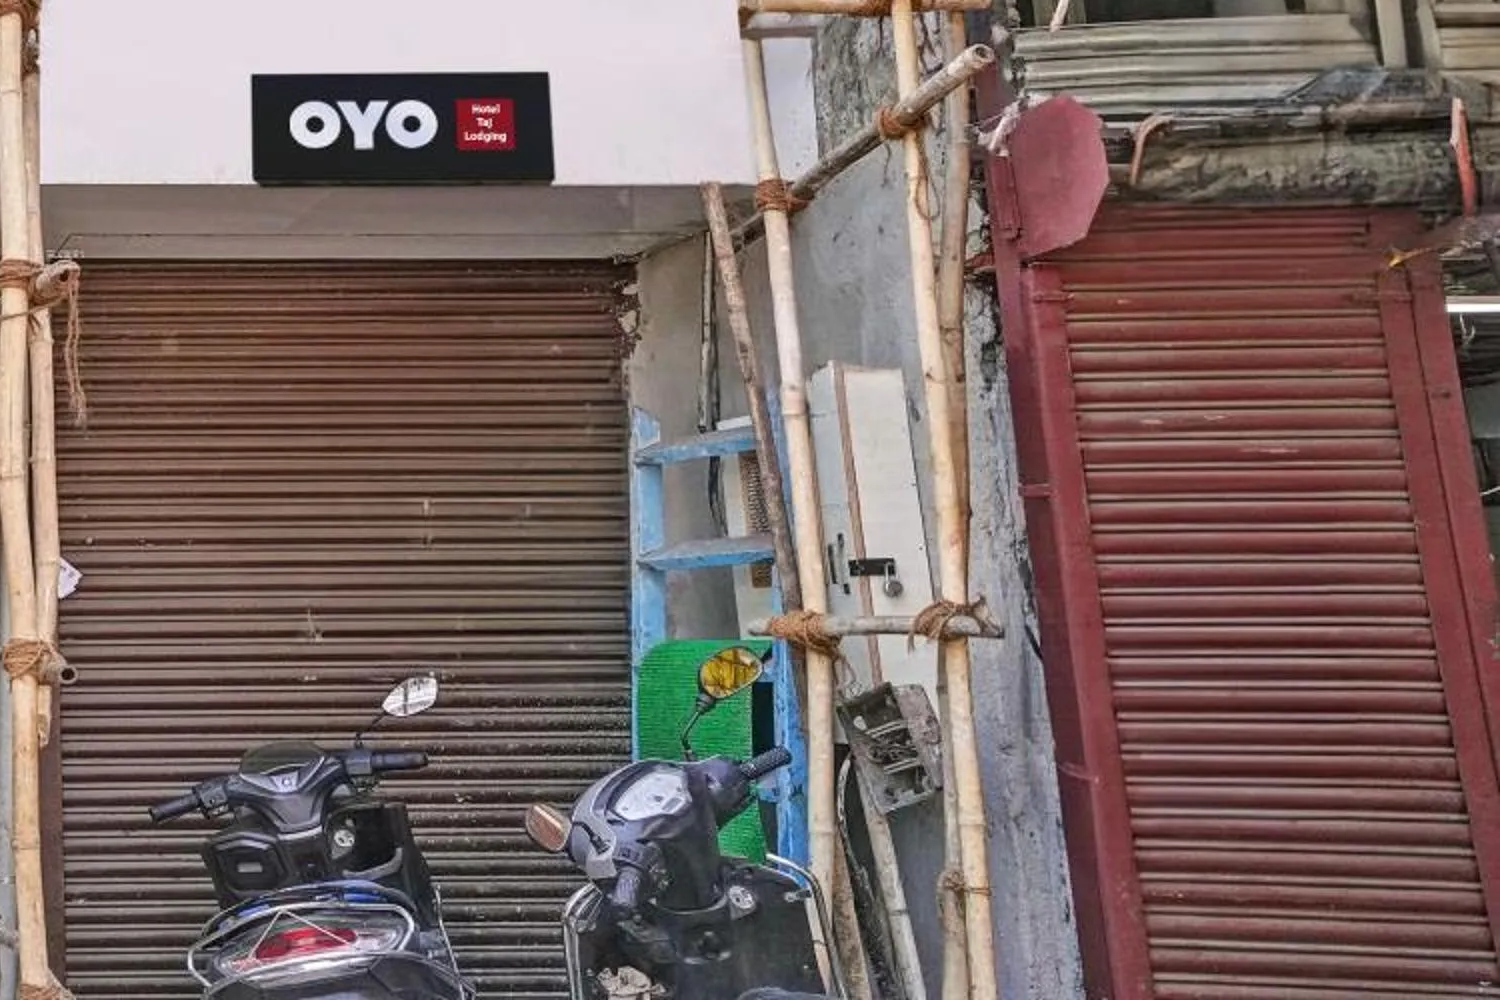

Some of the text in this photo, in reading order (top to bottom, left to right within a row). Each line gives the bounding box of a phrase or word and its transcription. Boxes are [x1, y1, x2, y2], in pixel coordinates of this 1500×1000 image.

[289, 100, 439, 150] OYO
[476, 117, 493, 129] Taj
[463, 131, 508, 143] Lodging
